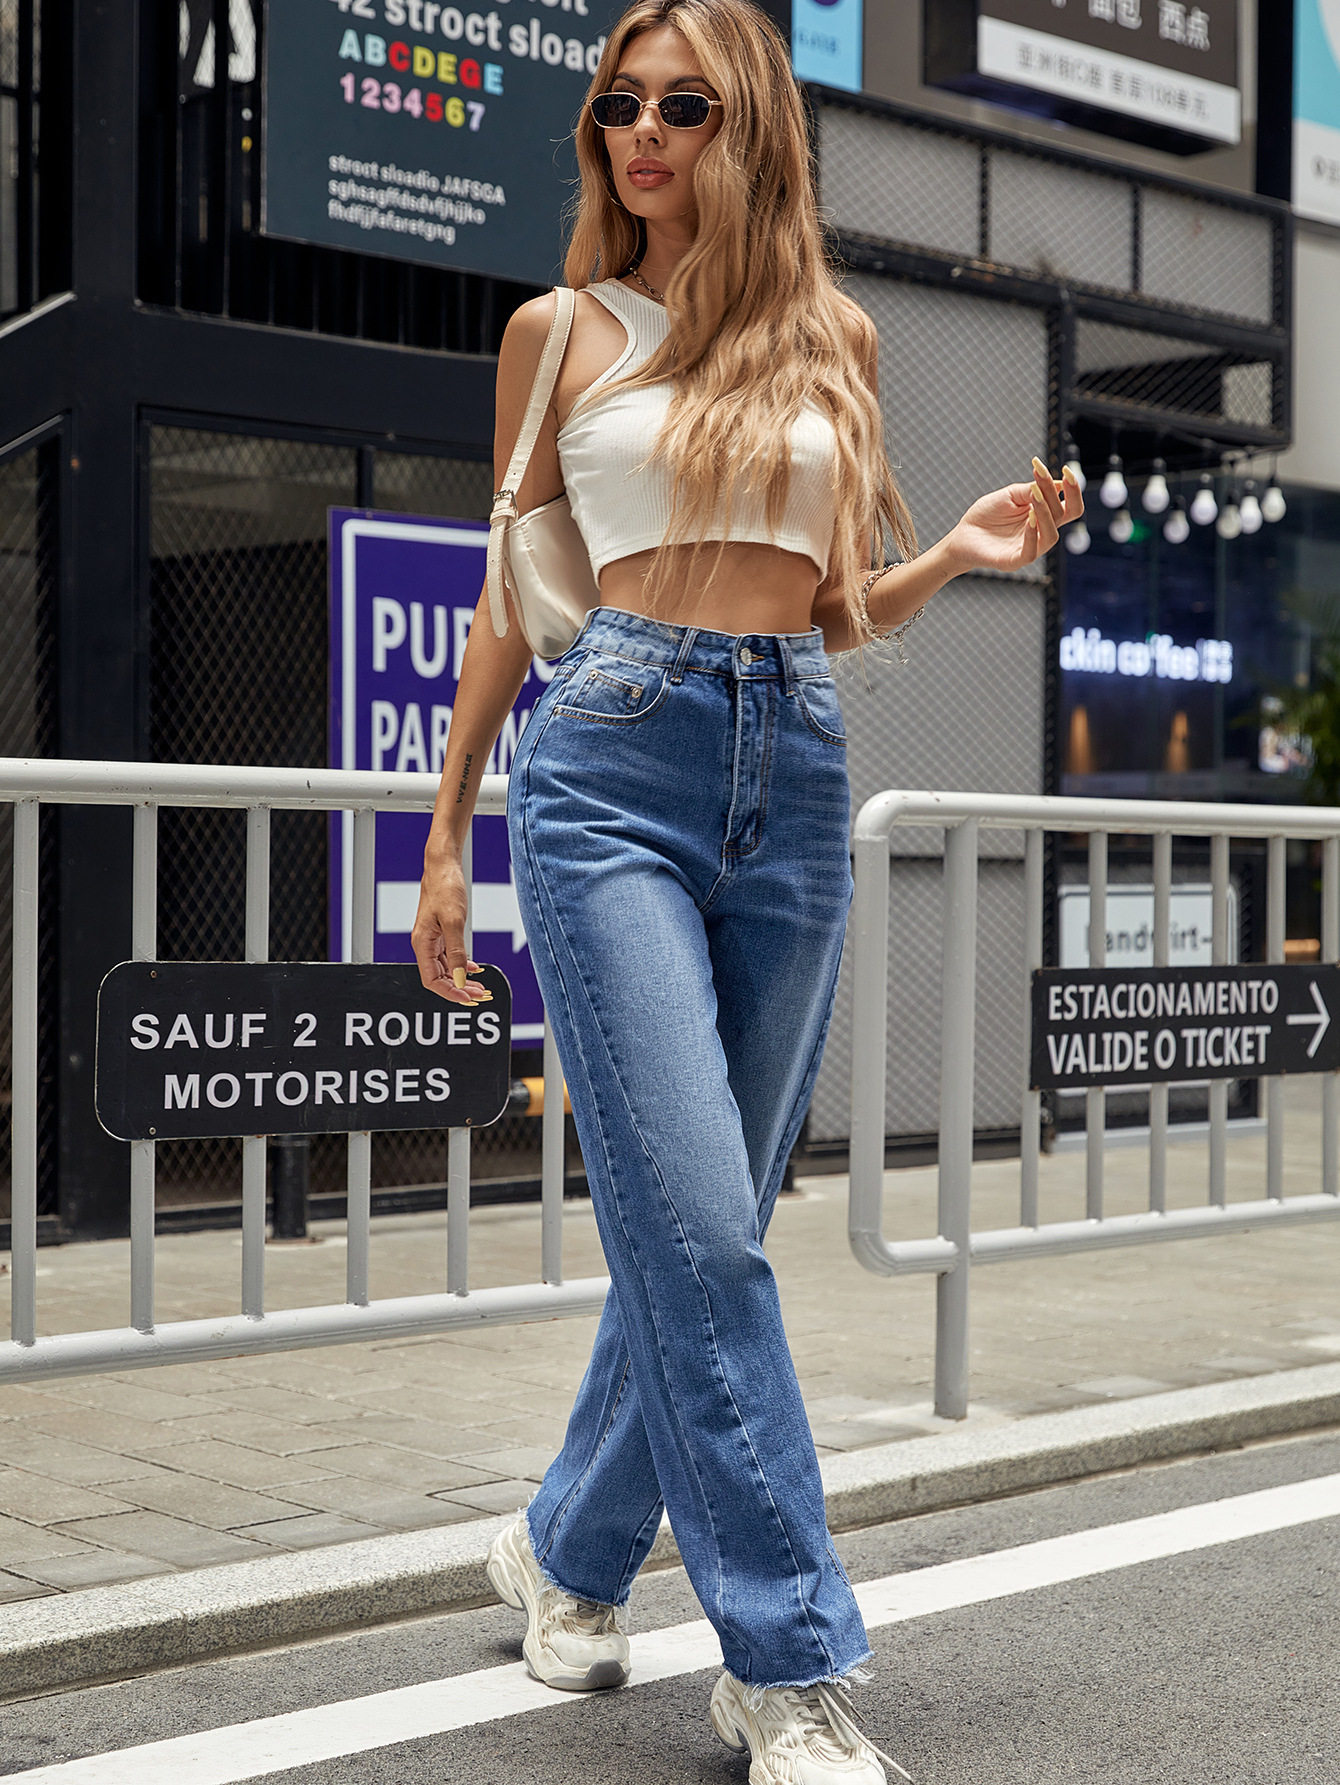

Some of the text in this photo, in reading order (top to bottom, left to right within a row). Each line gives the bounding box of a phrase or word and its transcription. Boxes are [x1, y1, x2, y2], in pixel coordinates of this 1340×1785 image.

[384, 0, 502, 51] stroct
[338, 29, 504, 95] ABCDEGE
[340, 73, 486, 131] 1234567
[1048, 979, 1279, 1021] ESTACIONAMENTO
[130, 1011, 501, 1050] SAUF 2 ROUES
[1046, 1025, 1272, 1075] VALIDE O TICKET
[164, 1067, 452, 1110] MOTORISES
